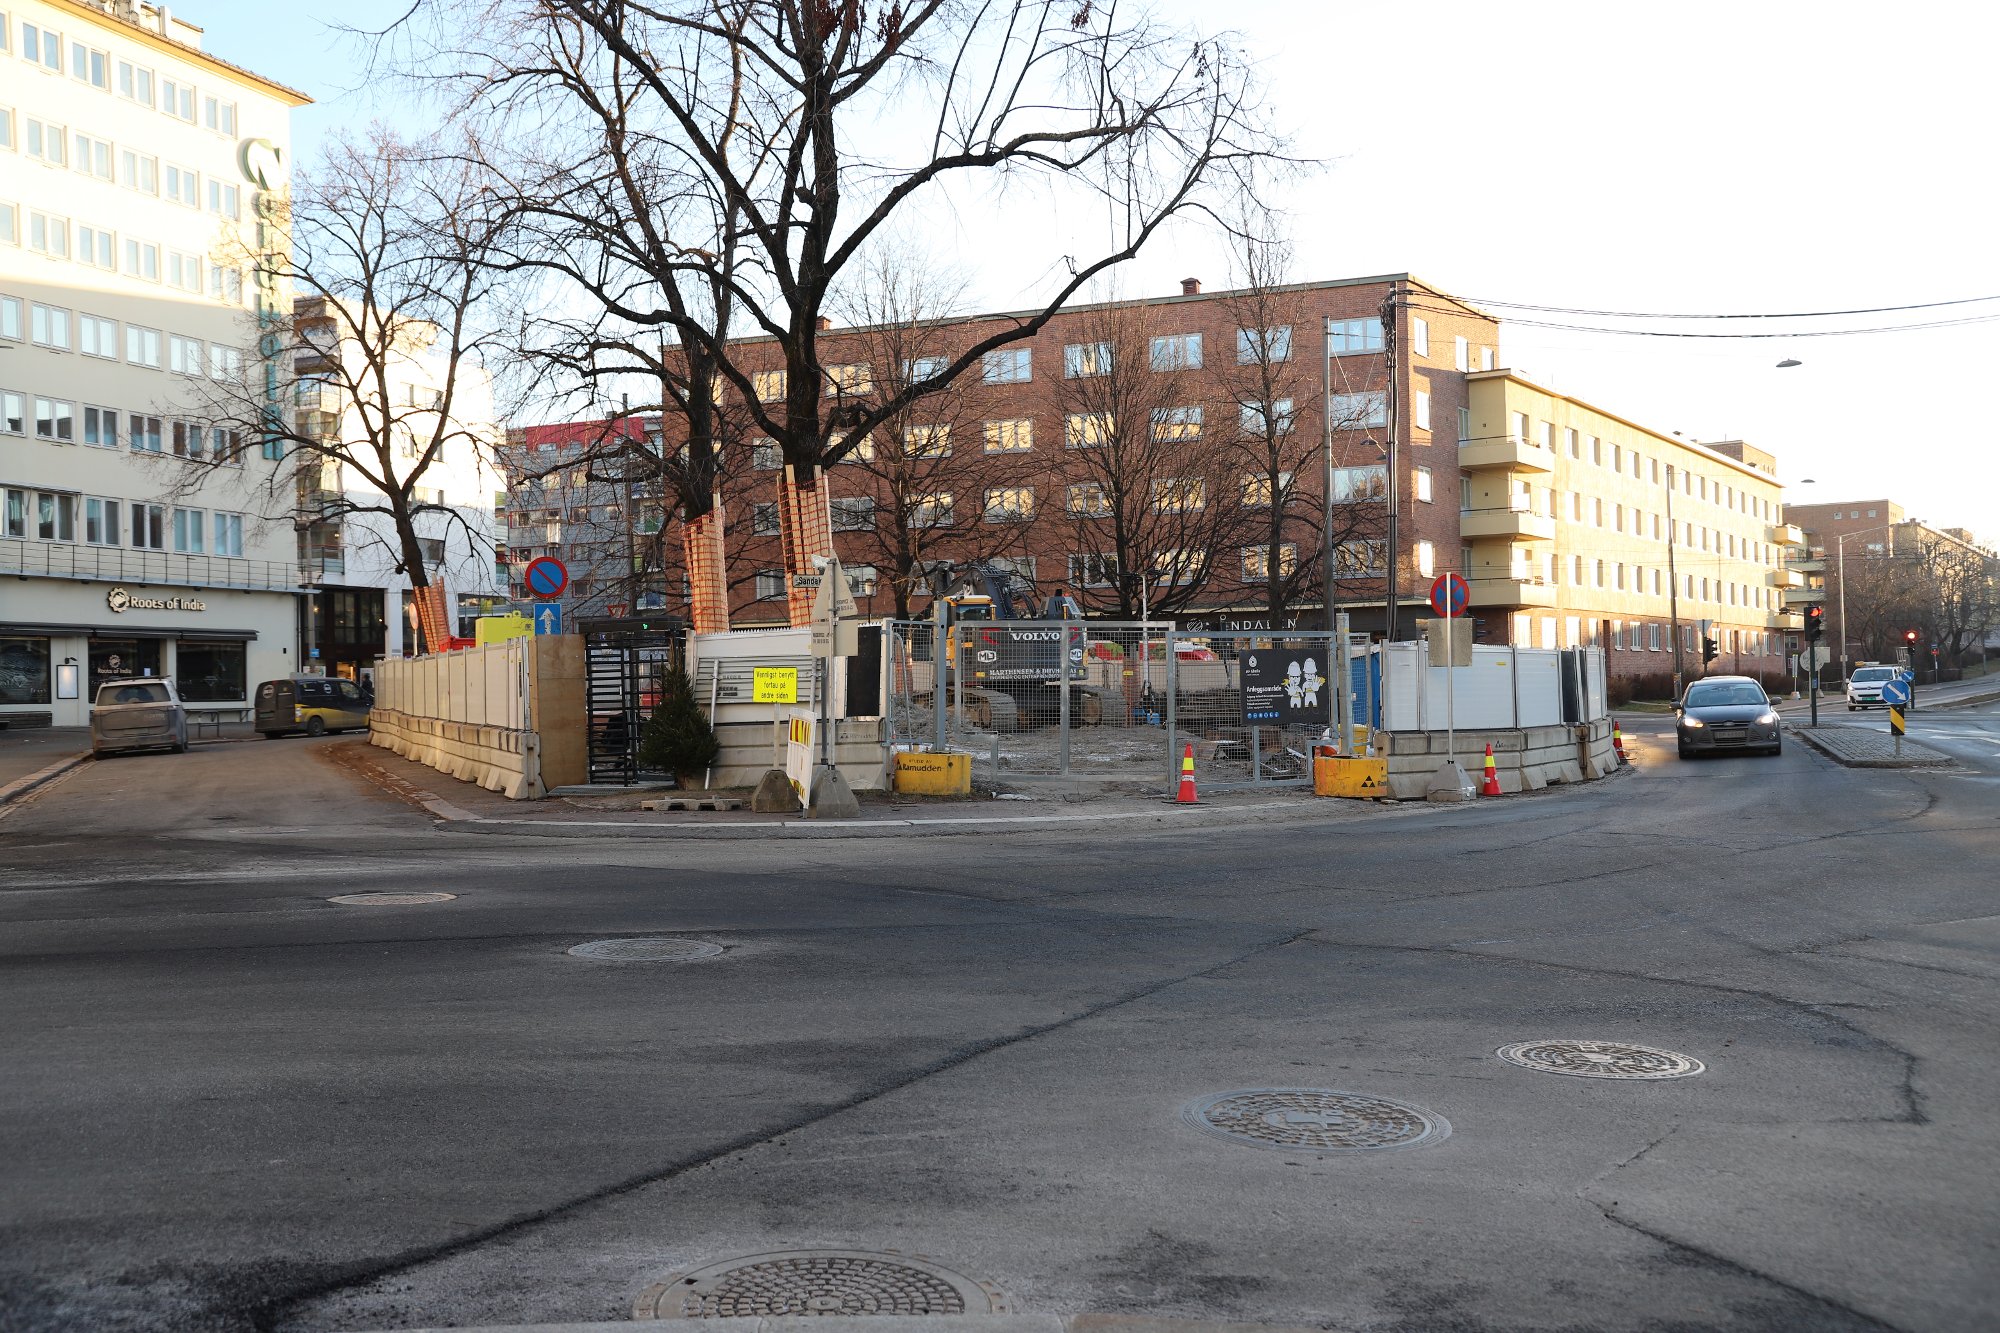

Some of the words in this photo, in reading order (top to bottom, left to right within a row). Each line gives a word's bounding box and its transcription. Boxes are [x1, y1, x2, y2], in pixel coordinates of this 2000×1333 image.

[131, 596, 165, 609] Roots
[166, 597, 179, 610] of
[181, 598, 206, 611] India
[1011, 632, 1060, 640] VOLVO
[757, 671, 777, 679] Vennligst
[779, 671, 795, 679] benytt
[780, 681, 786, 690] på
[902, 763, 942, 772] Ramudden
